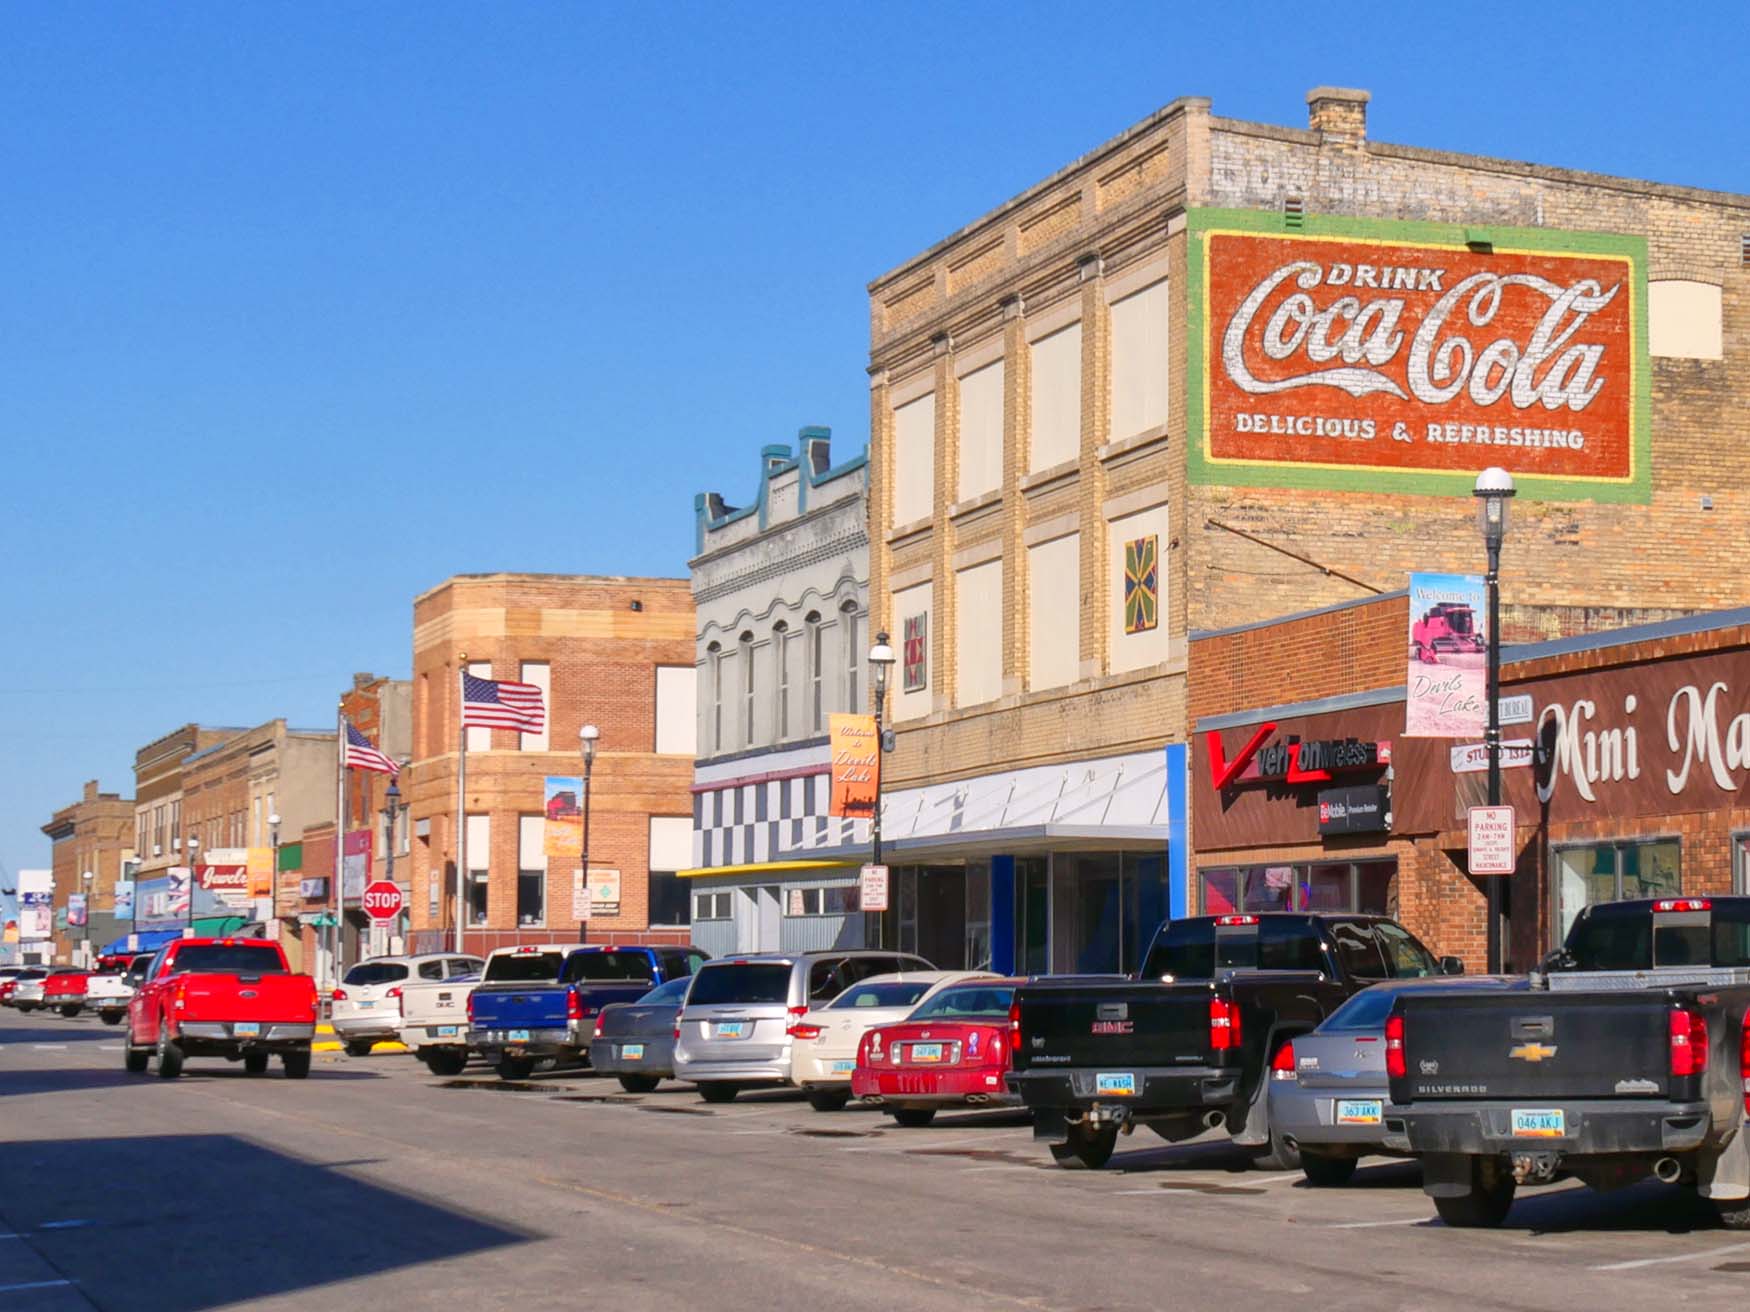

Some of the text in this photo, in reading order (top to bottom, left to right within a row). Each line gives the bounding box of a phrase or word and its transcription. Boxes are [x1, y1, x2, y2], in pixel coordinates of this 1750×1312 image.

[1326, 263, 1446, 291] DRINK
[1235, 412, 1584, 449] DELICIOUS & REFRESHING
[1416, 587, 1480, 602] Welcome to
[1413, 674, 1462, 698] Devils
[1439, 692, 1480, 715] Lake
[1537, 695, 1641, 803] Mini
[834, 751, 877, 767] Devils
[836, 766, 871, 784] Lake
[1487, 811, 1496, 820] NO
[1474, 823, 1508, 831] PARKING
[365, 892, 401, 908] STOP
[1091, 1021, 1135, 1033] GMC
[1418, 1084, 1488, 1093] SILVERADO
[1517, 1116, 1559, 1129] 046 AKJ
